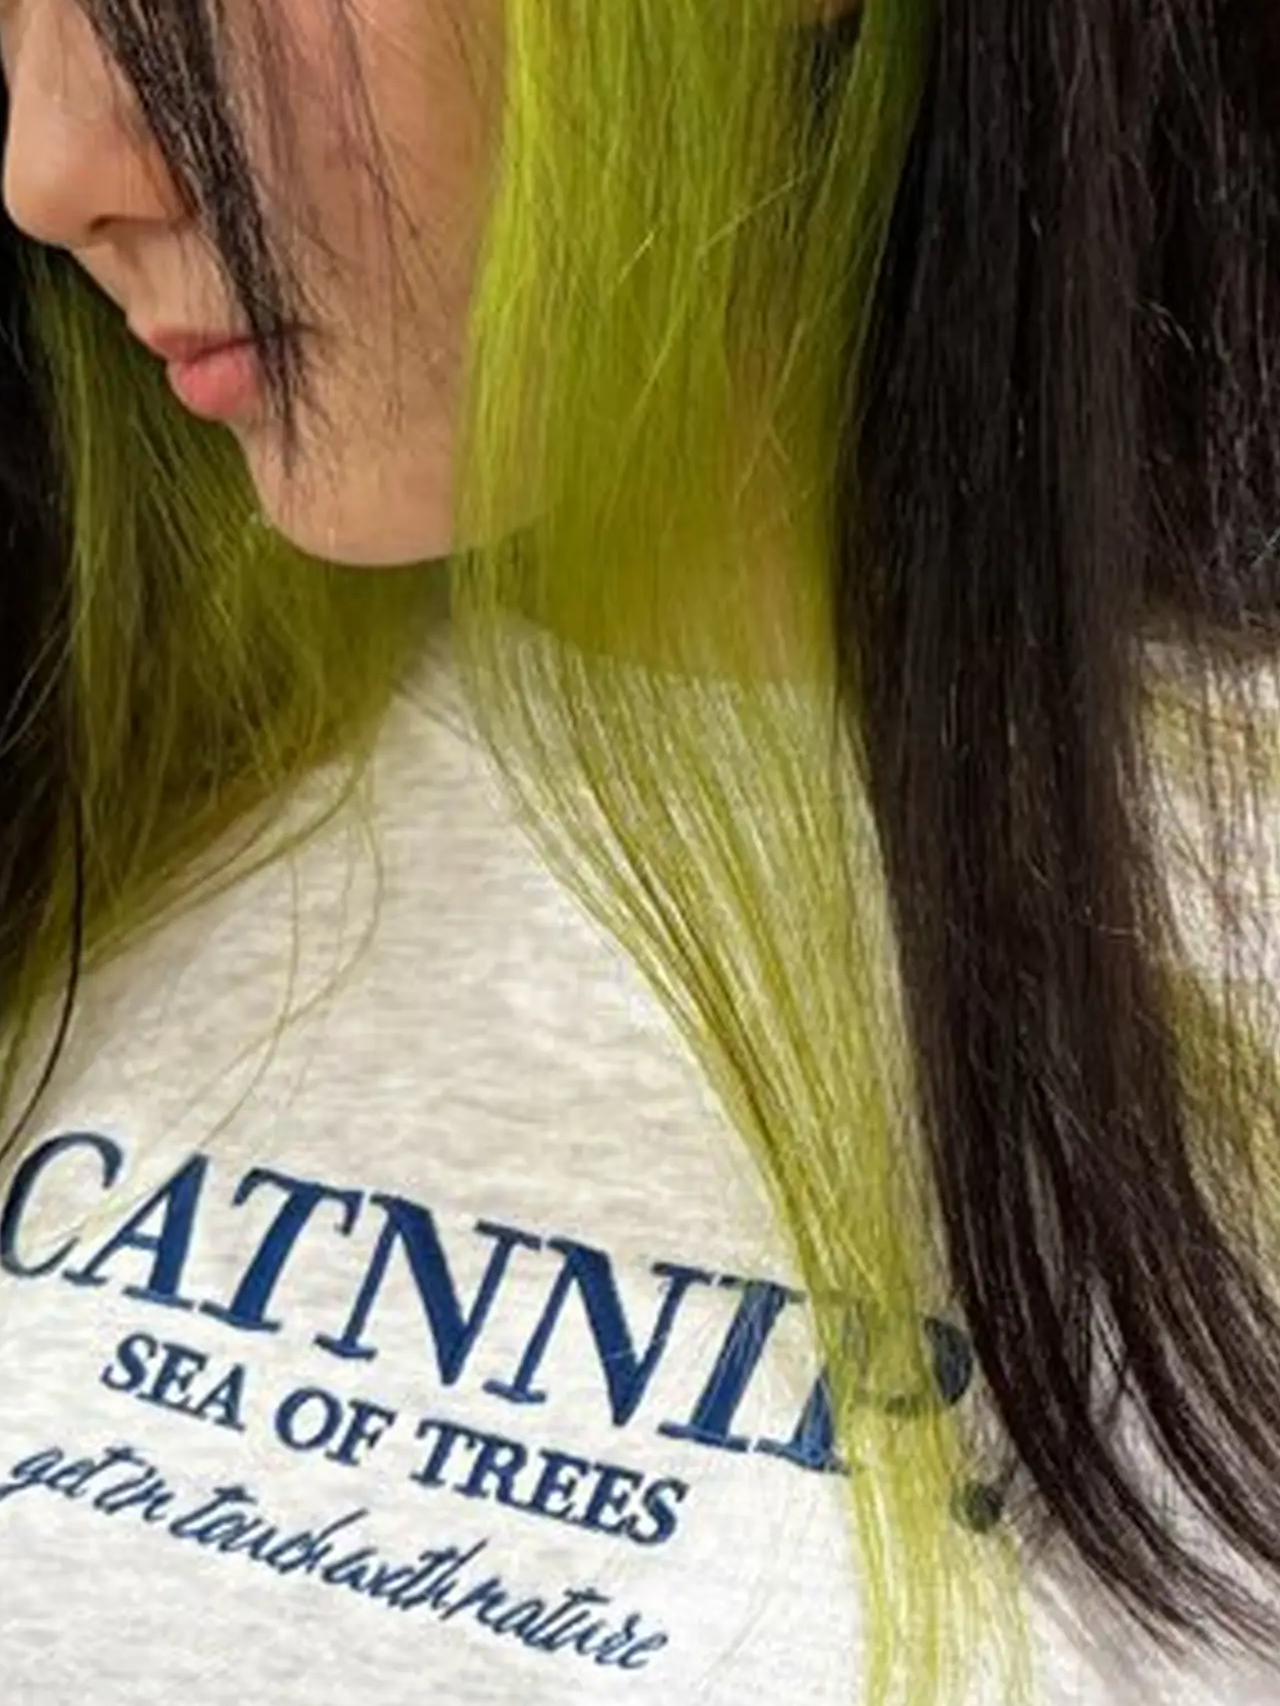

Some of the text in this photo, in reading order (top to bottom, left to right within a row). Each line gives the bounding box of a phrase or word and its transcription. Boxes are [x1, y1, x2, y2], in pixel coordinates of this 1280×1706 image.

[100, 1333, 690, 1547] SEA OF TREES
[442, 1583, 670, 1671] nature
